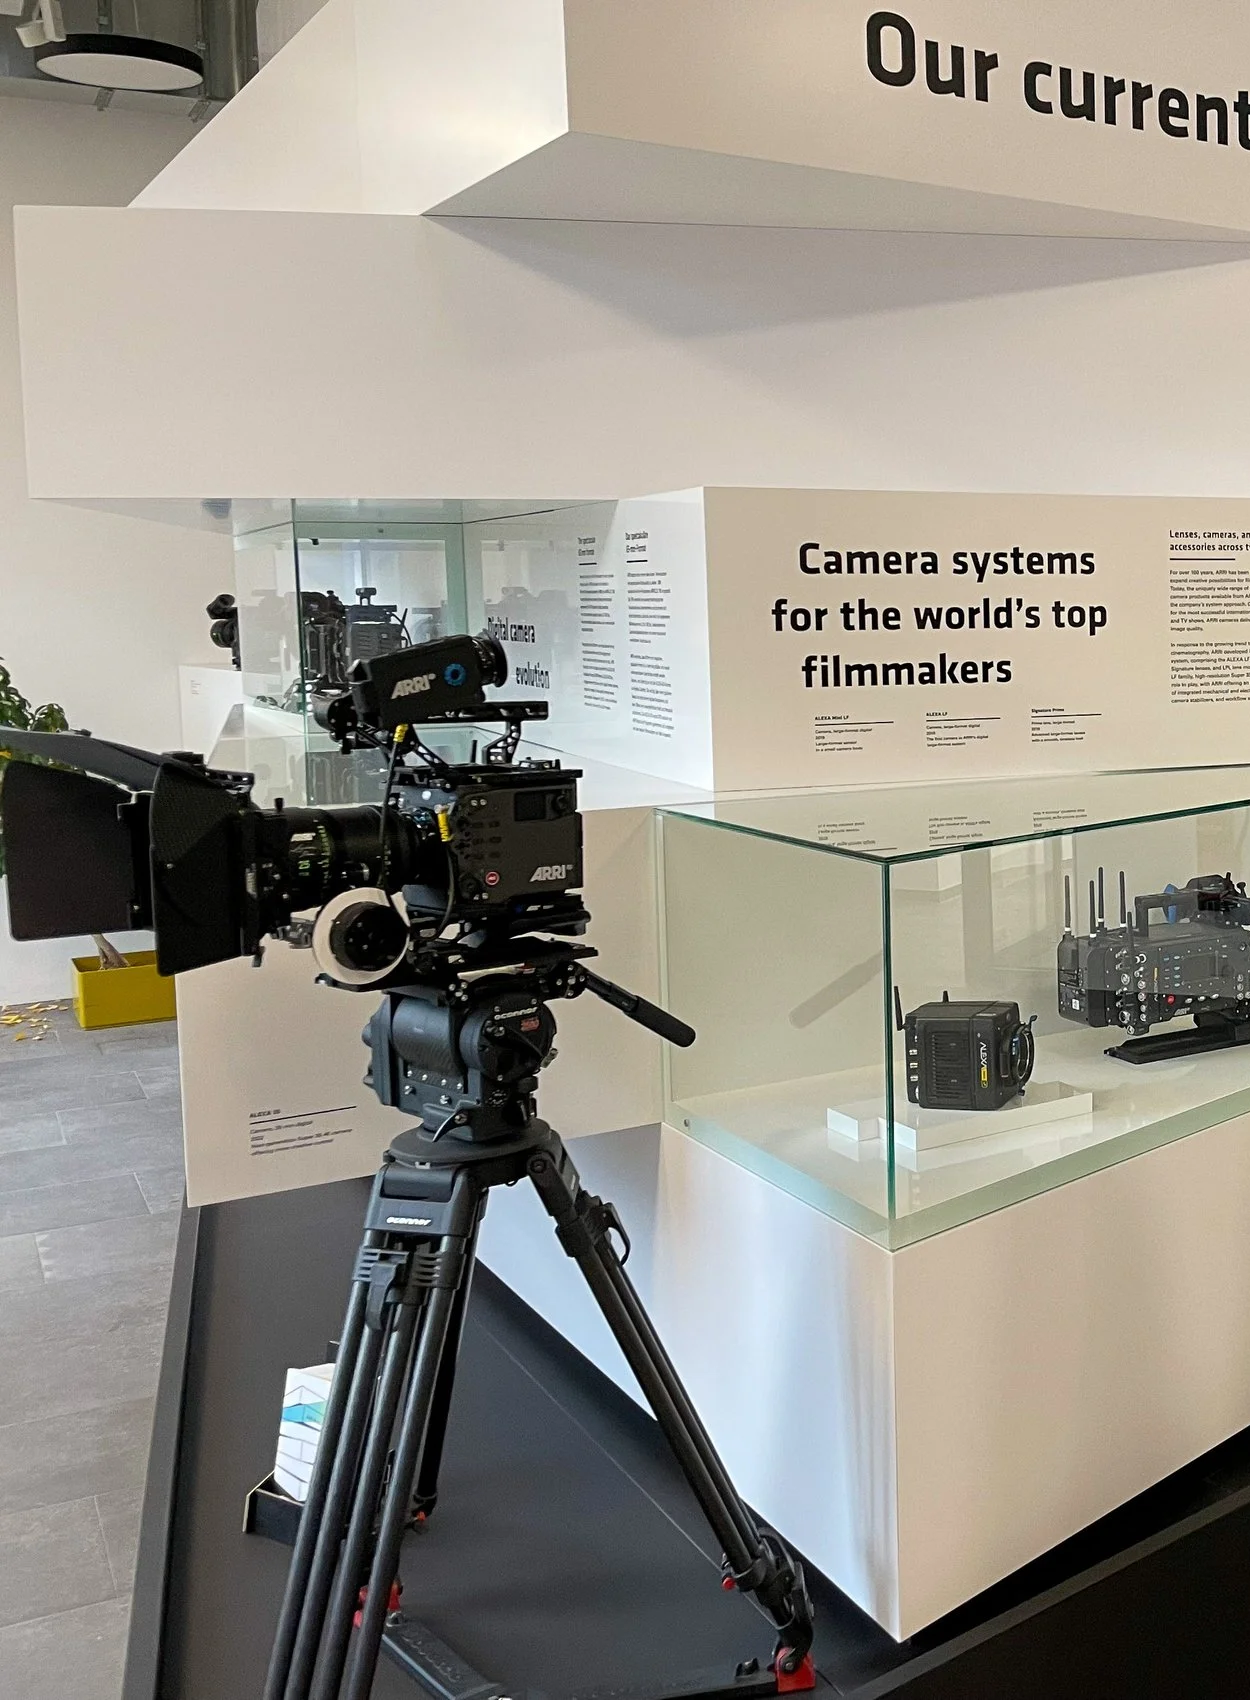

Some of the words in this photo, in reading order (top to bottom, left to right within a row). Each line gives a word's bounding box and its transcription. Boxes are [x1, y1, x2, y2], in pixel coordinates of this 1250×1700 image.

[866, 11, 999, 101] Our
[1170, 530, 1200, 539] Lenses,
[1203, 531, 1239, 540] cameras,
[1170, 543, 1216, 551] accessories
[799, 543, 938, 575] Camera
[952, 547, 1095, 583] systems
[772, 599, 828, 631] for
[840, 598, 901, 630] the
[1052, 600, 1107, 636] top
[510, 624, 535, 643] camera
[516, 661, 550, 689] evolution
[801, 653, 1012, 688] filmmakers
[390, 674, 431, 700] ARRI
[530, 864, 566, 882] ARRI
